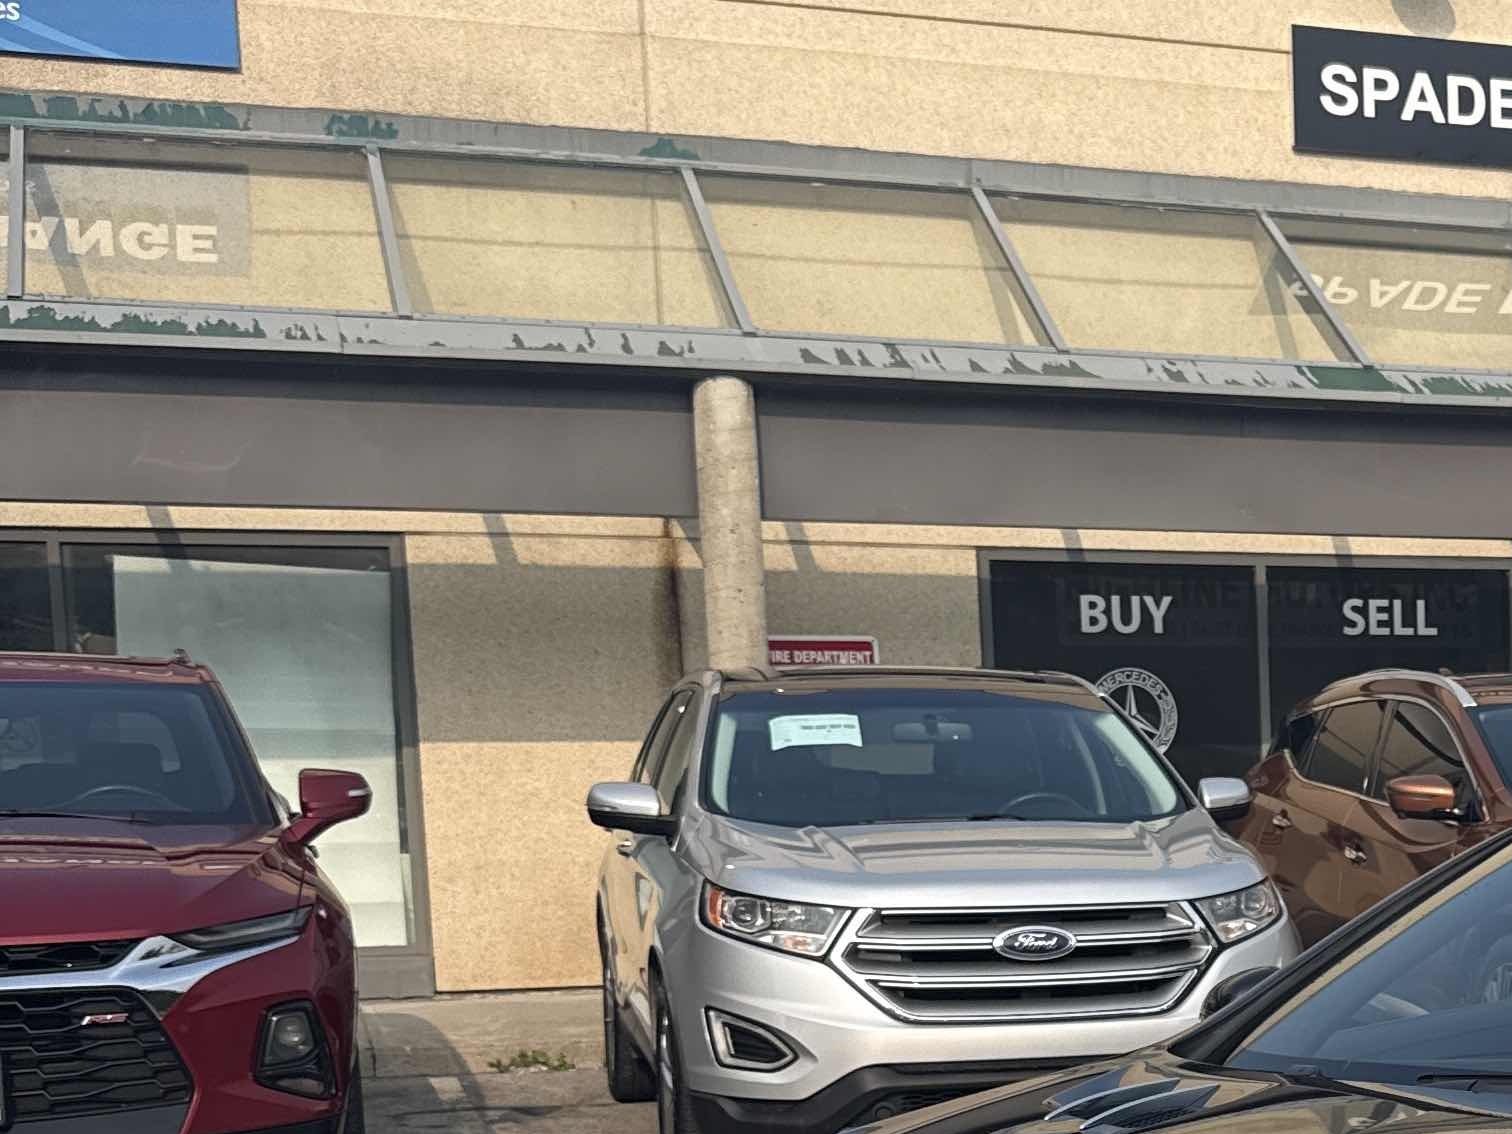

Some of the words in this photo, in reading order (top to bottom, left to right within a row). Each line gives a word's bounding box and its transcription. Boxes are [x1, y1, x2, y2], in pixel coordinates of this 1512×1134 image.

[1079, 594, 1173, 634] BUY
[1342, 598, 1438, 636] SELL
[770, 651, 791, 663] IRE
[793, 651, 873, 665] DEPARTMENT
[1014, 933, 1059, 948] Ford
